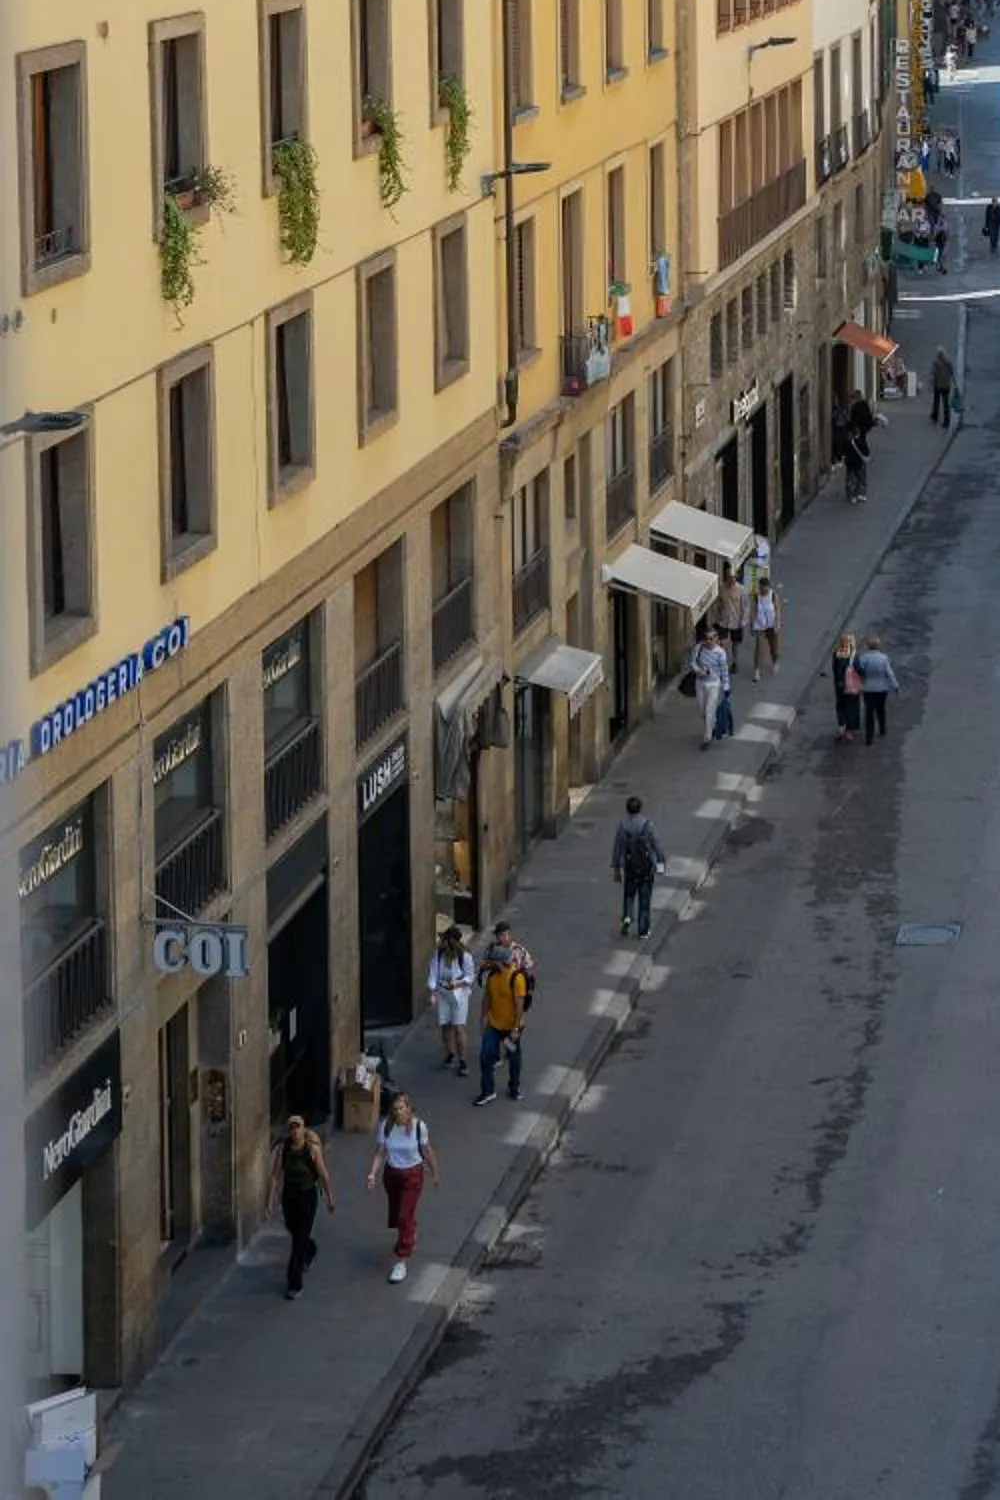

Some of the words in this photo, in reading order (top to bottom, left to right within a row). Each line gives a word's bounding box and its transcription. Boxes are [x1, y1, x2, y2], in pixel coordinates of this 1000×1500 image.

[41, 652, 145, 754] OROLOGERIA
[363, 756, 391, 812] LUSH
[153, 928, 249, 977] COI
